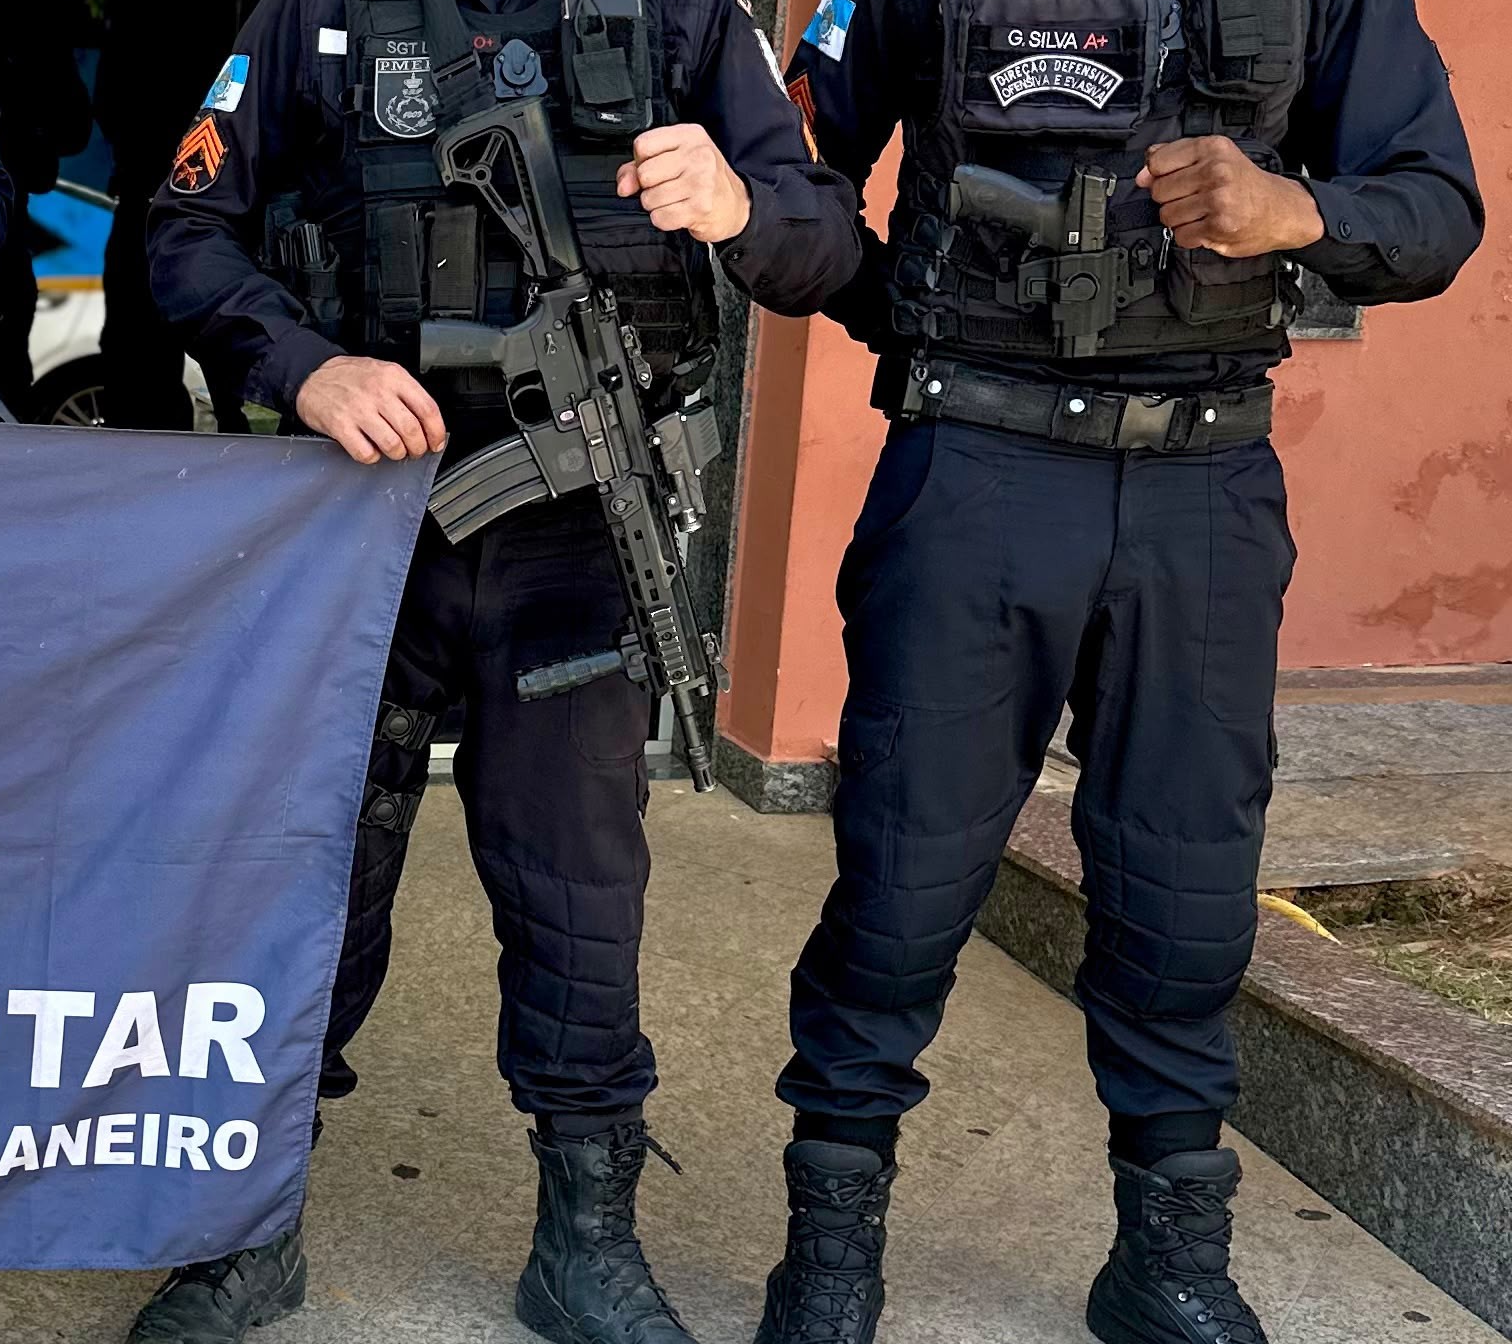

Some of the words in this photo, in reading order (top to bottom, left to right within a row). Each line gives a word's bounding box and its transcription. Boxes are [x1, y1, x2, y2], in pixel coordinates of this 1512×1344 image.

[386, 40, 418, 55] SGT
[1007, 29, 1026, 47] G.
[1028, 30, 1078, 50] SILVA
[1083, 32, 1109, 50] A+
[1053, 59, 1115, 90] DEFENSIVA
[1054, 75, 1062, 86] E
